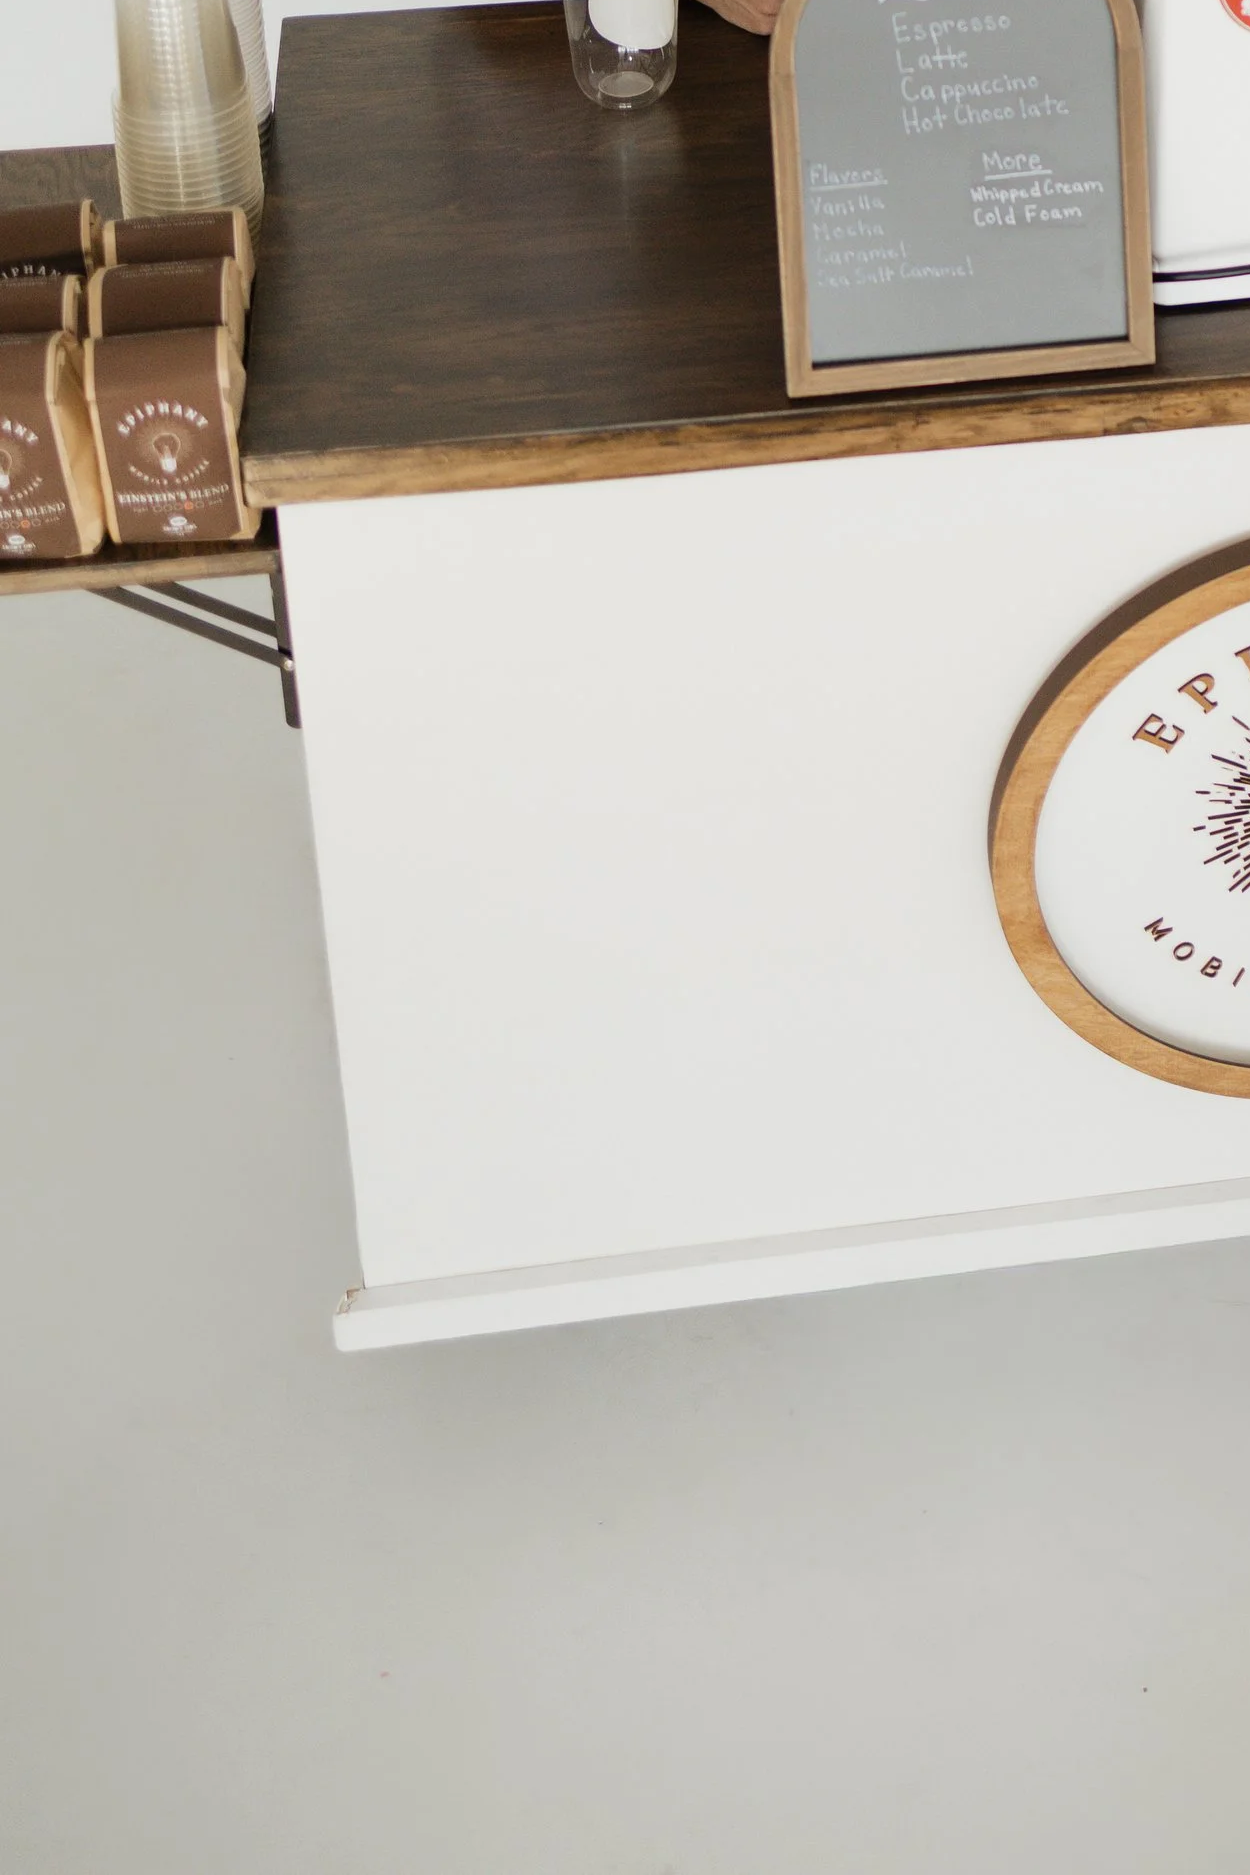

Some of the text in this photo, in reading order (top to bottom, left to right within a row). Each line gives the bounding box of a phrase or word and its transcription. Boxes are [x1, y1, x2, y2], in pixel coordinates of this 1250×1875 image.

[892, 11, 1012, 45] Espresso
[896, 51, 969, 74] Latte
[900, 75, 1040, 104] Cappuccino
[904, 94, 1070, 135] Hot Chocolate
[981, 150, 1044, 172] More
[810, 162, 888, 186] Flavors
[970, 177, 1105, 204] Whipped Cream
[810, 193, 886, 217] Vanilla
[972, 203, 1084, 228] Cold Foam
[812, 219, 885, 242] Mocha
[815, 240, 908, 265] Caramel
[900, 255, 974, 279] Caramel
[189, 483, 230, 500] BLEND
[25, 501, 66, 518] BLEND
